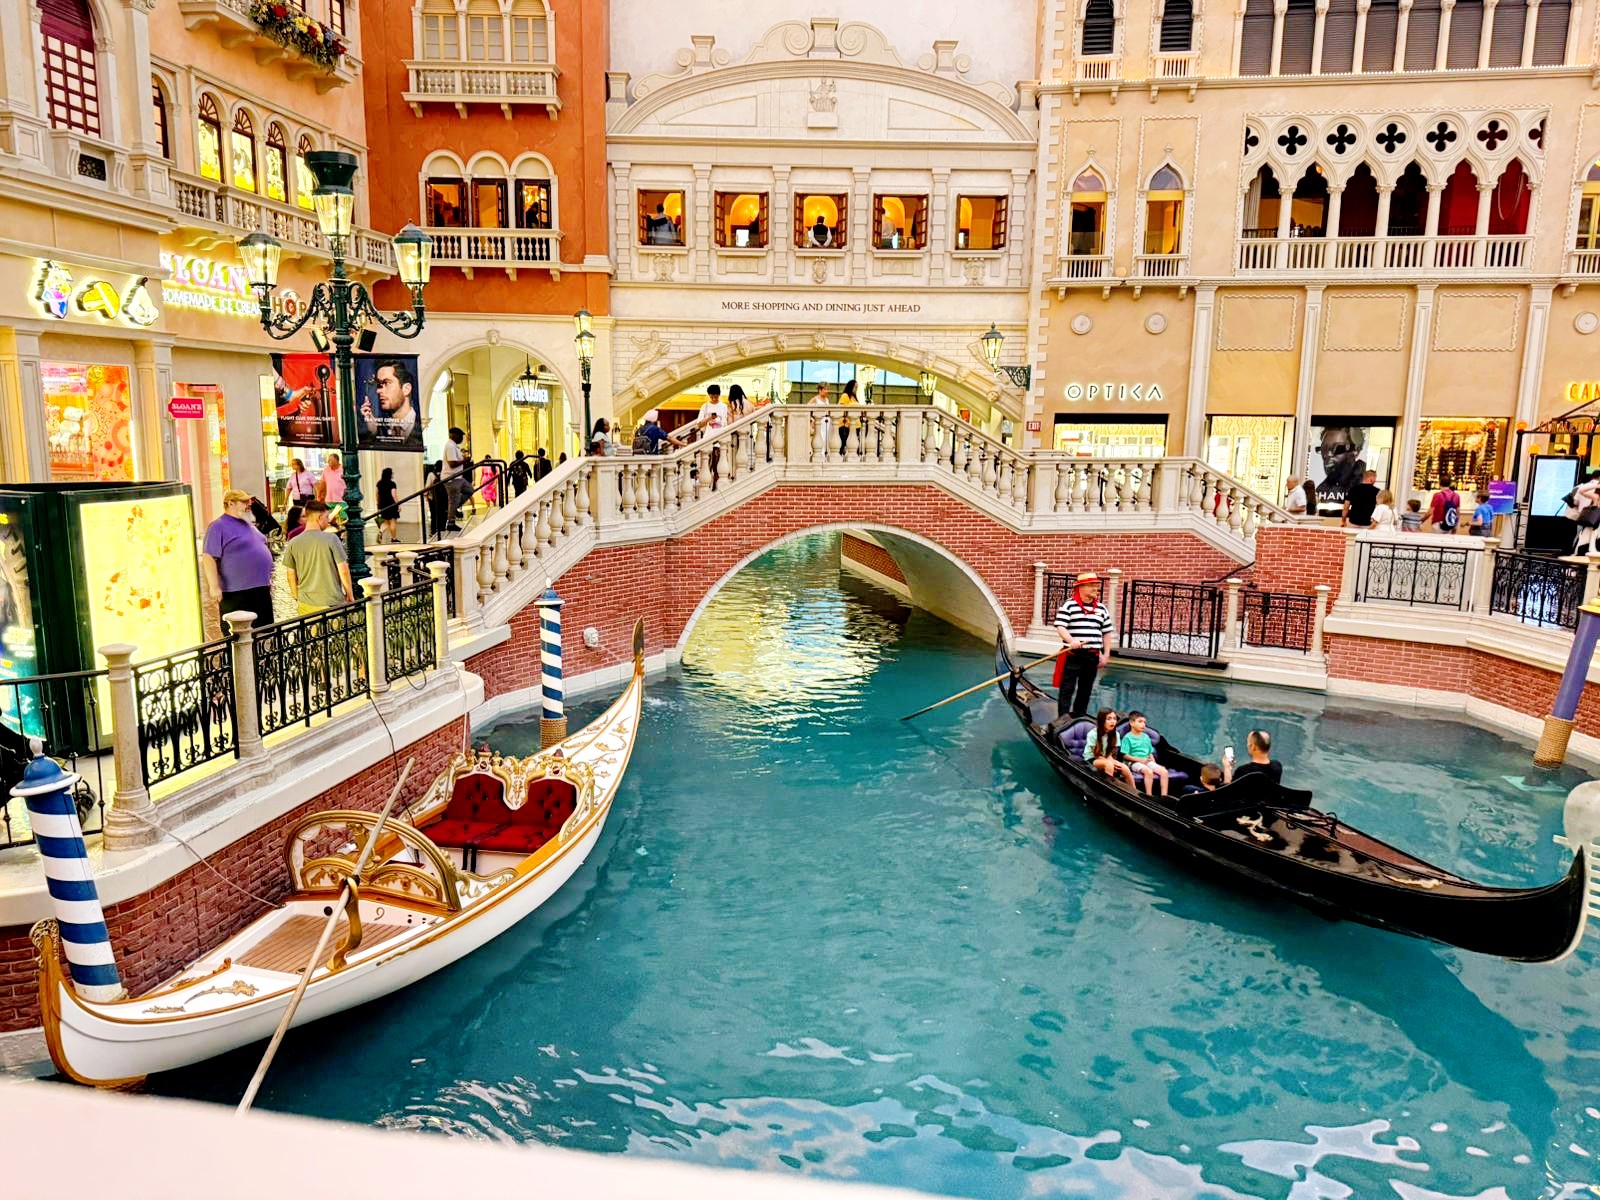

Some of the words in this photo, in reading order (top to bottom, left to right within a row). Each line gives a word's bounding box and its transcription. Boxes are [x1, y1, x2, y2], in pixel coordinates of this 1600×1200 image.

[236, 300, 261, 316] CREA
[721, 301, 750, 310] MORE
[752, 302, 800, 311] SHOPPING
[802, 303, 823, 312] AND
[825, 303, 861, 312] DINING
[862, 304, 886, 314] JUST
[887, 304, 921, 313] AHEAD
[1028, 422, 1040, 431] EXIT
